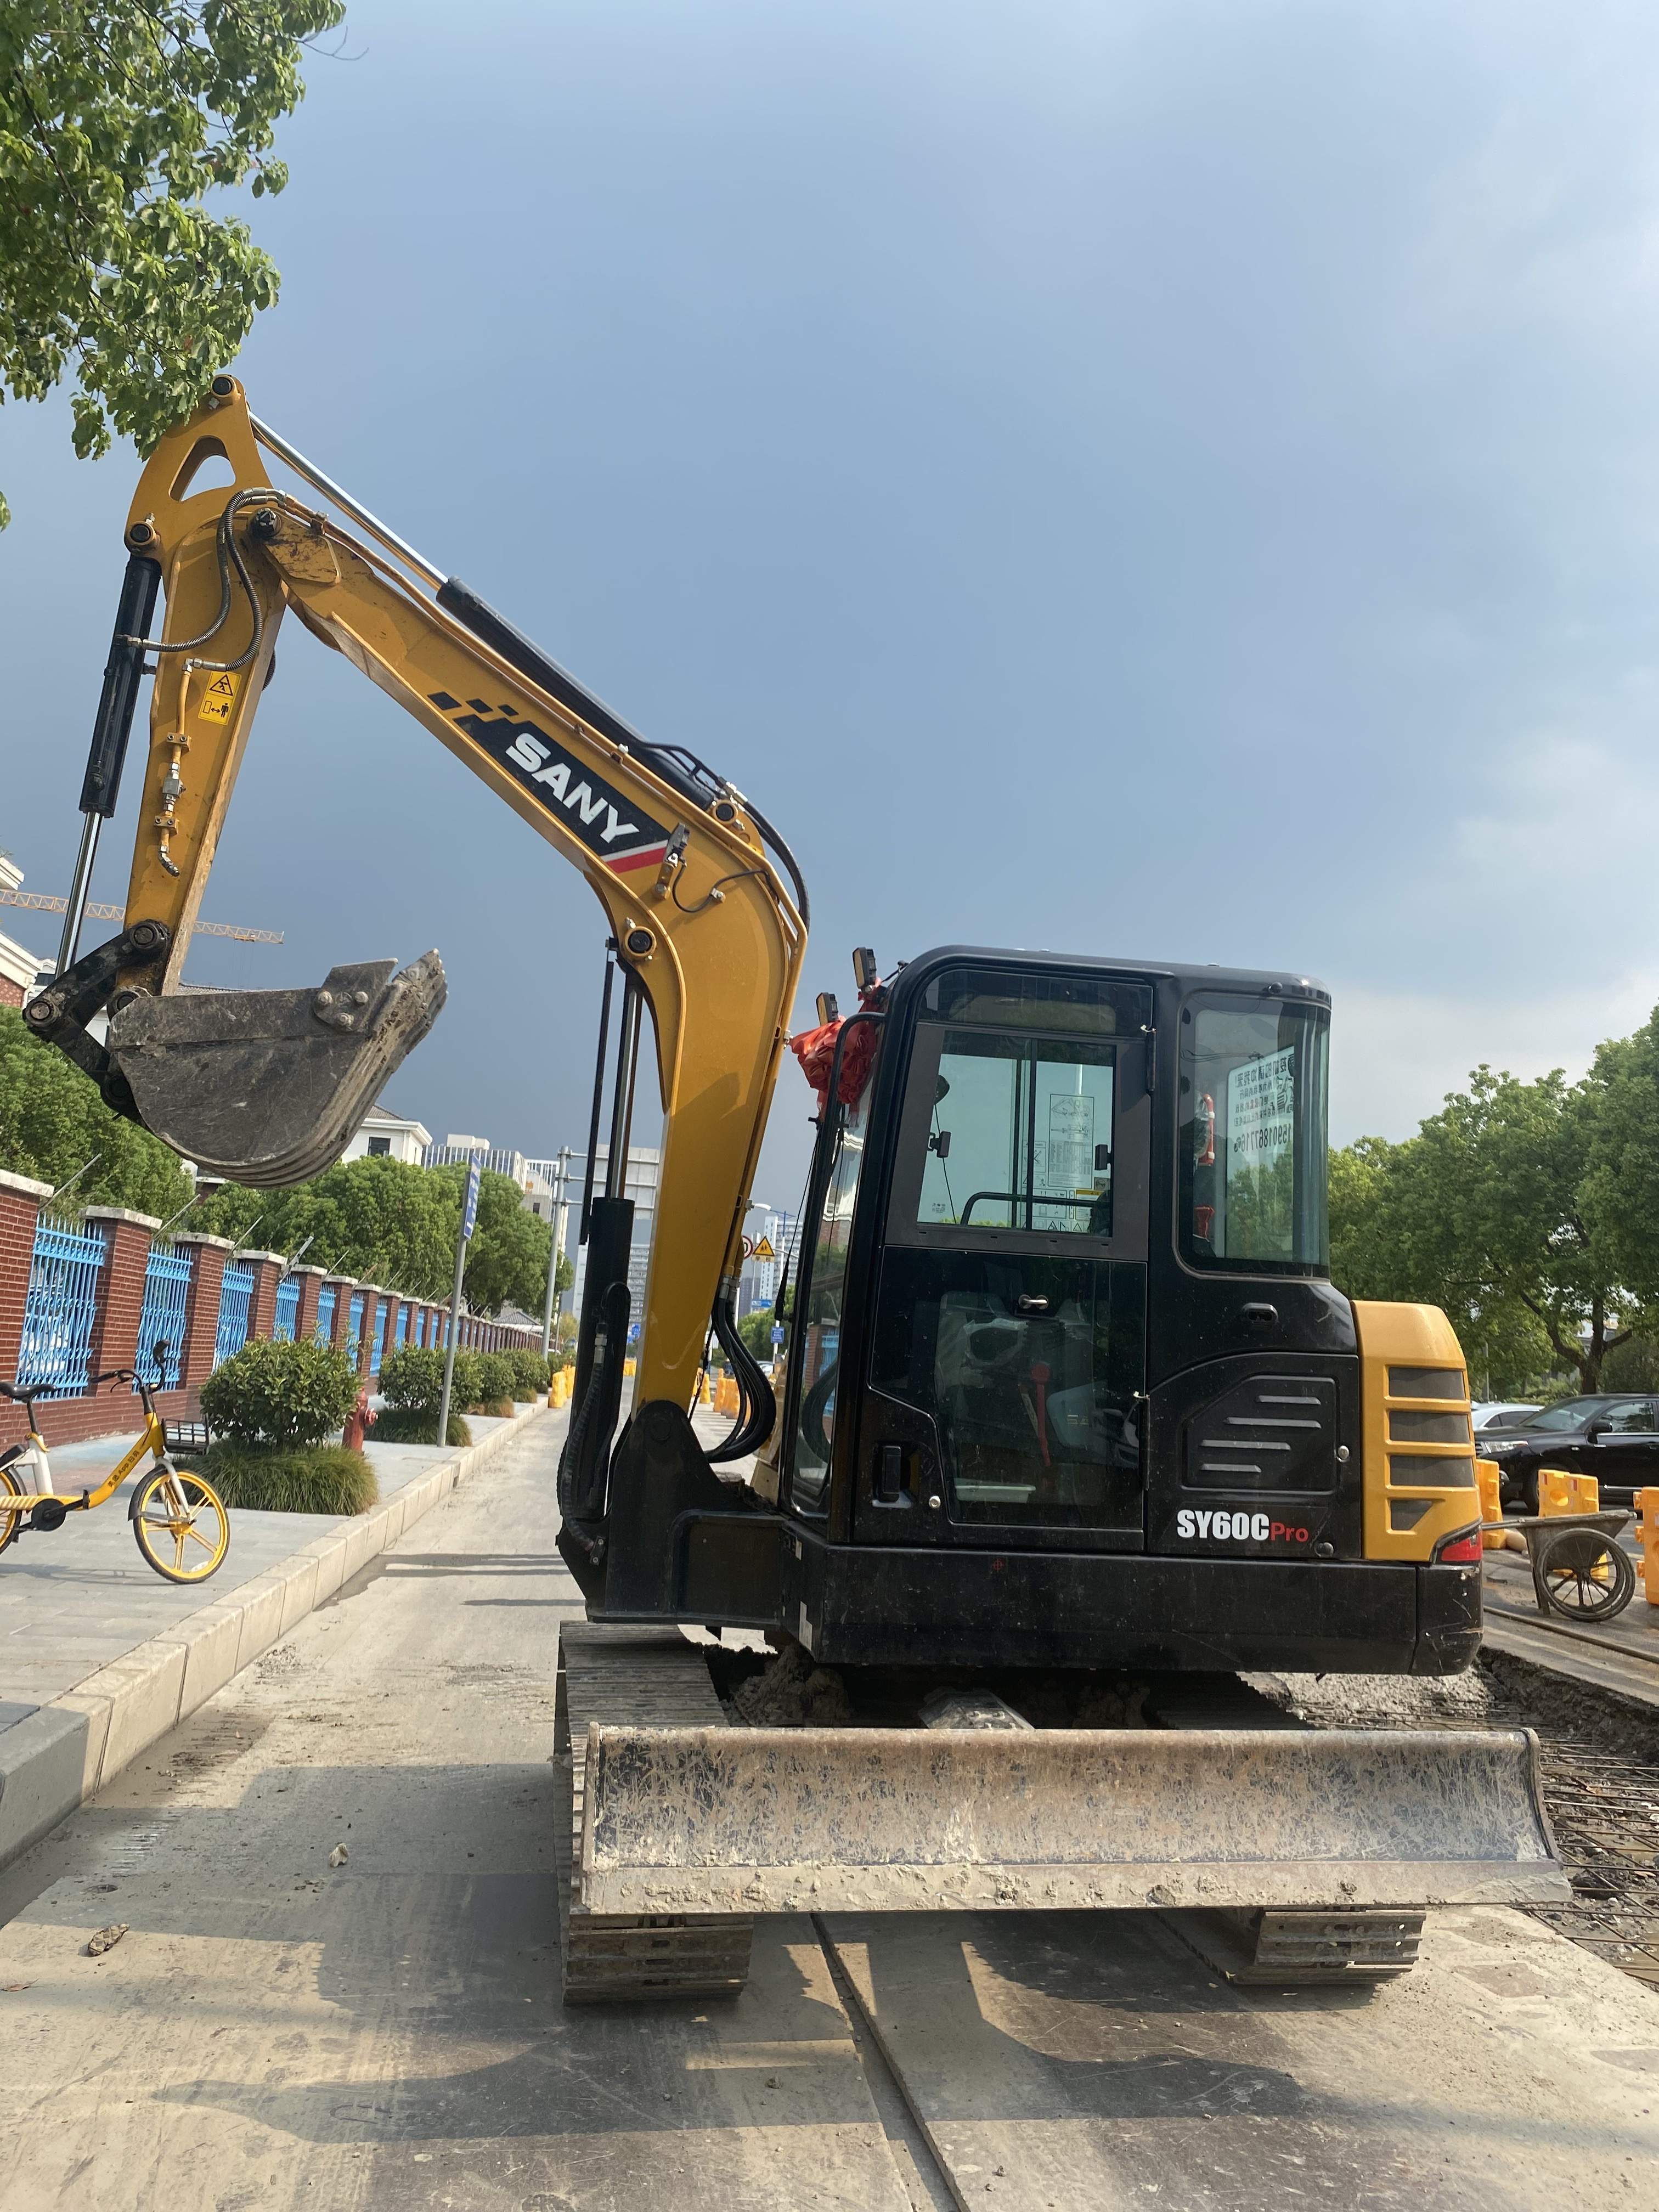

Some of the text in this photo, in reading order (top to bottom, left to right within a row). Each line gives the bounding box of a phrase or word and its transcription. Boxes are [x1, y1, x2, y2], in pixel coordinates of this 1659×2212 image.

[505, 733, 640, 843] SANY
[1177, 1509, 1309, 1542] SY60C Pro
